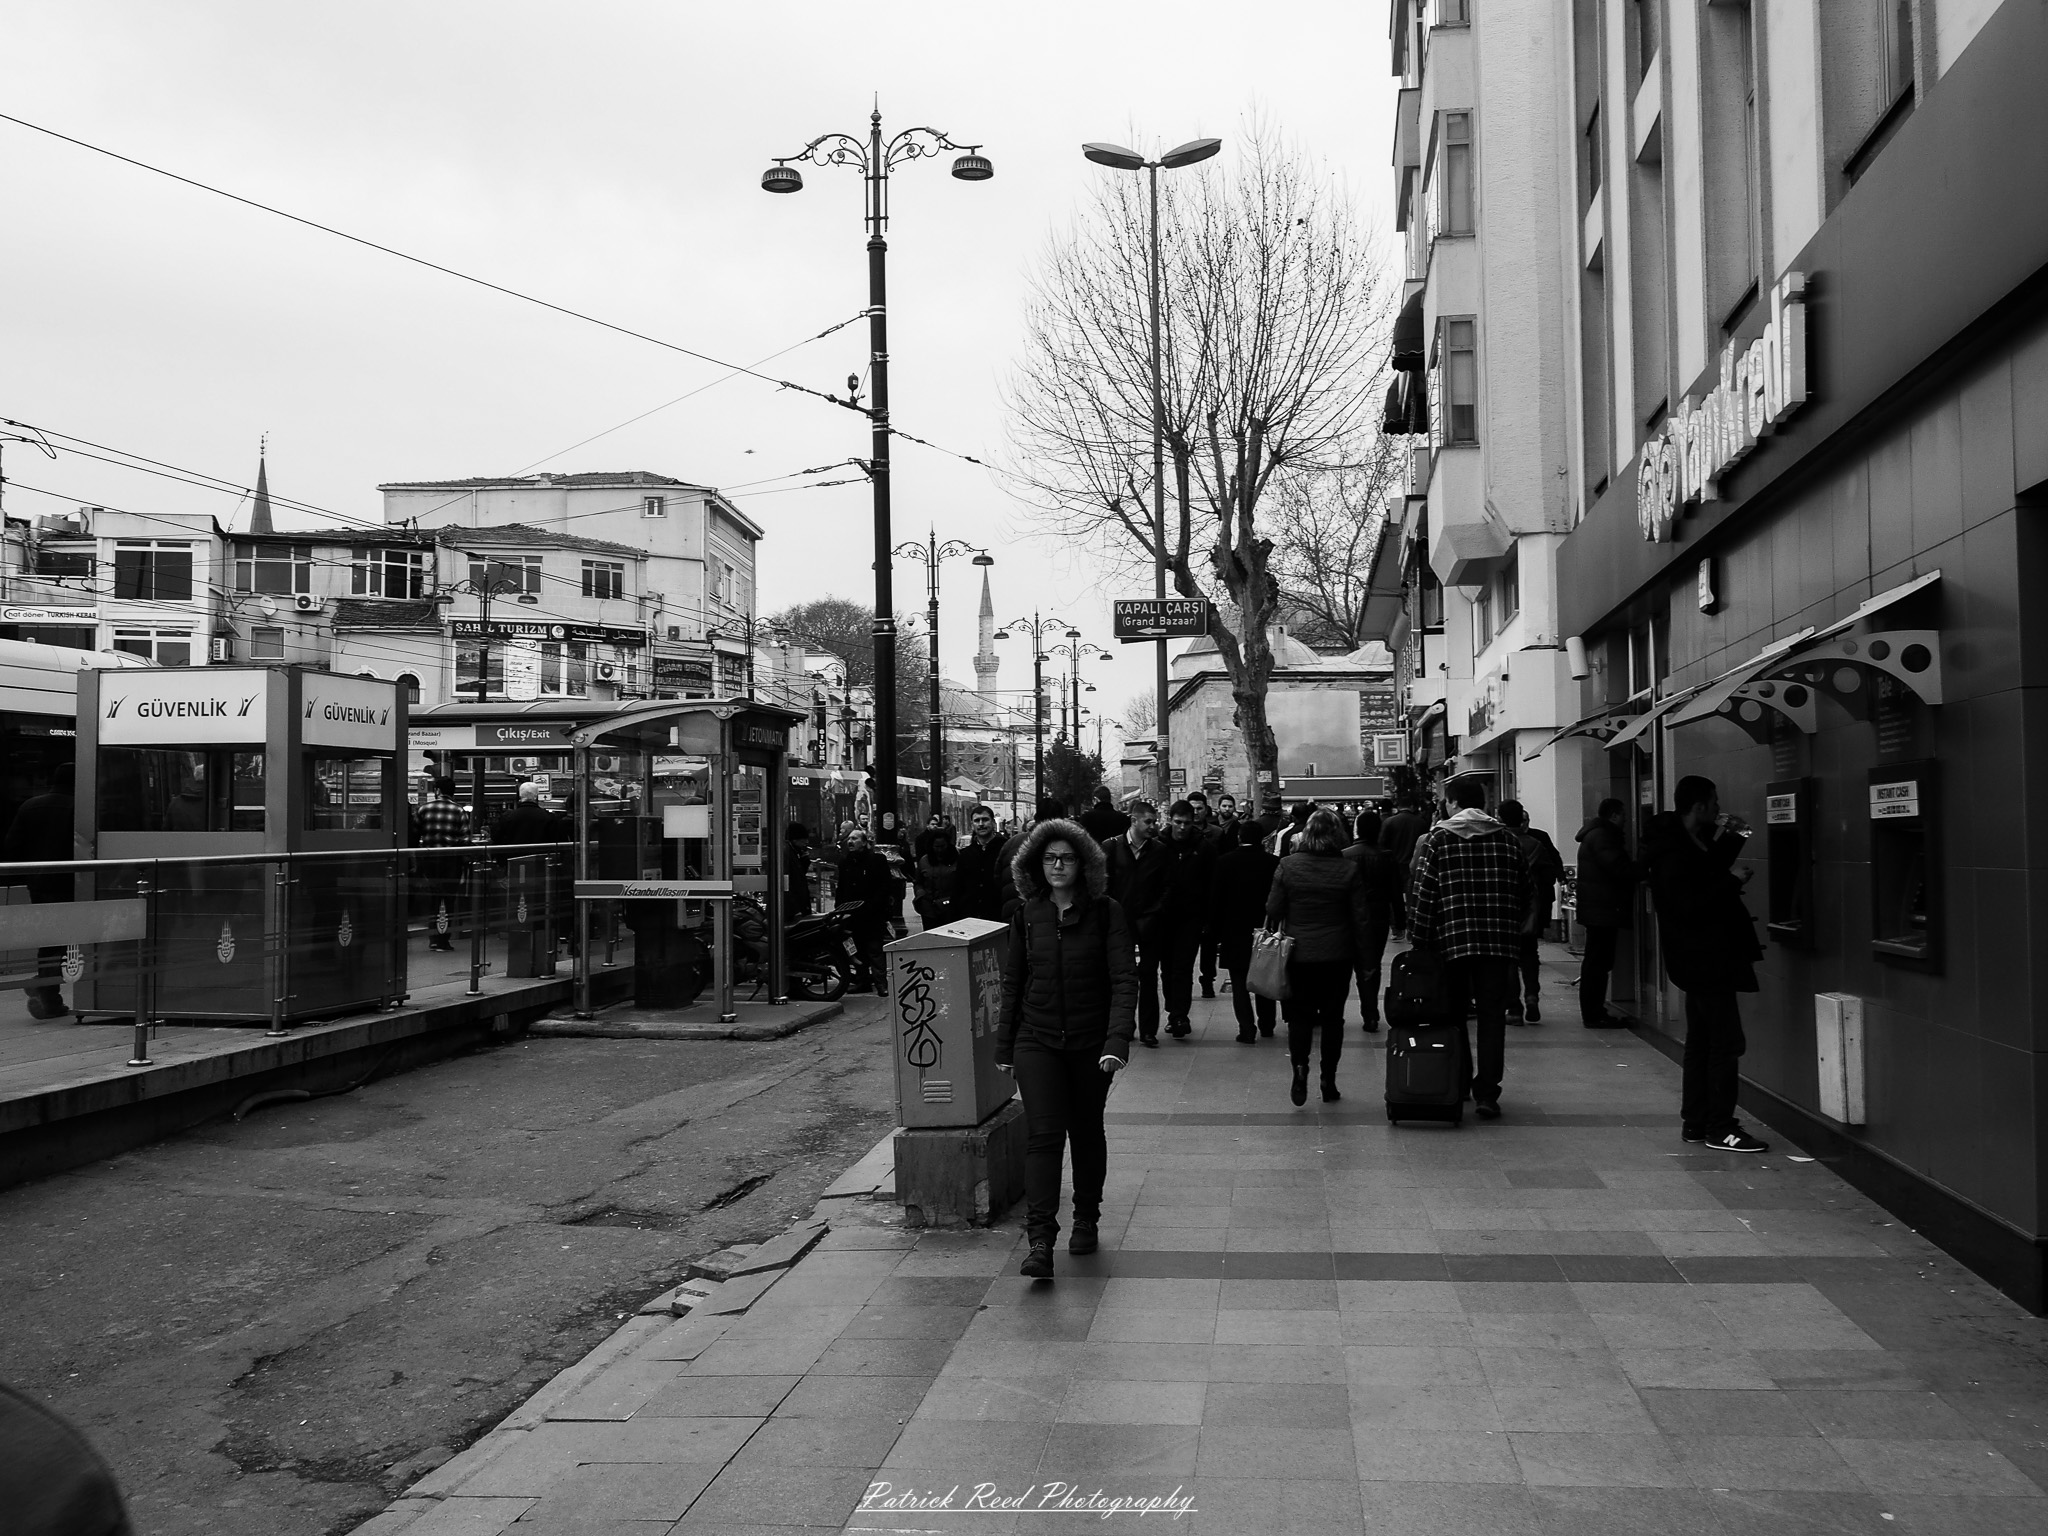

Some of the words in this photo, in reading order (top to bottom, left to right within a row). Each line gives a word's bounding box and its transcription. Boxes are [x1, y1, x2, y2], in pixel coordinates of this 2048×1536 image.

[1117, 602, 1160, 614] KAPALI
[1166, 602, 1204, 615] ÇARŞI
[1122, 616, 1154, 627] (Grand
[1160, 615, 1197, 626] Bazaar)
[455, 622, 494, 633] SAHL
[498, 623, 548, 634] TURİZM
[137, 698, 228, 718] GÜVENLİK
[324, 702, 376, 725] GÜVENLİK
[818, 728, 826, 761] SILVER
[791, 776, 809, 786] CASIO
[1722, 1133, 1741, 1147] N
